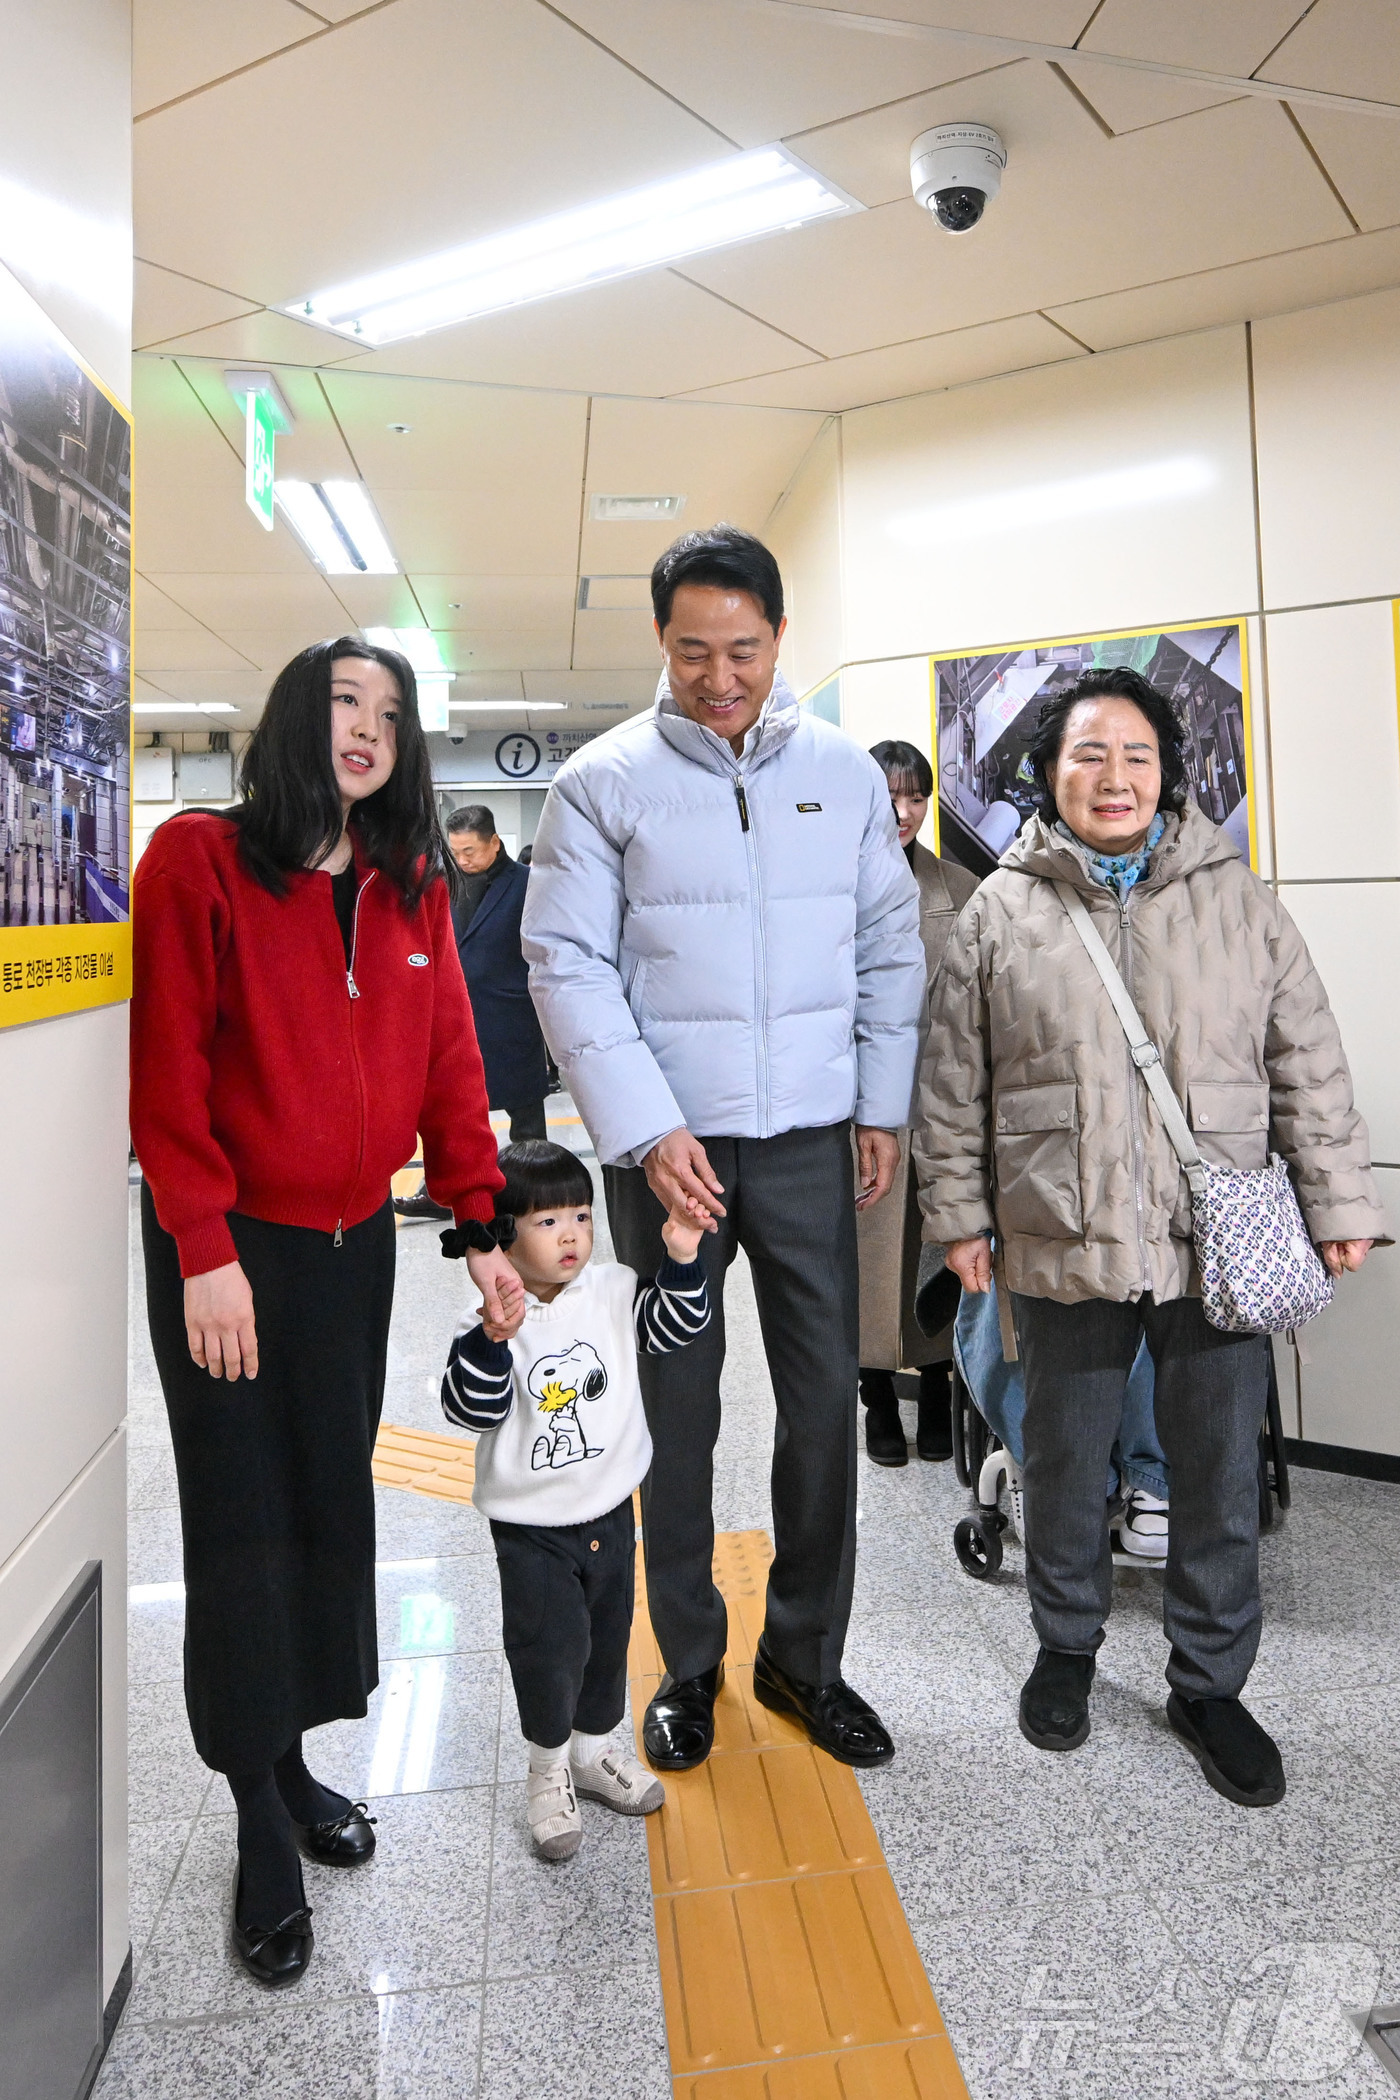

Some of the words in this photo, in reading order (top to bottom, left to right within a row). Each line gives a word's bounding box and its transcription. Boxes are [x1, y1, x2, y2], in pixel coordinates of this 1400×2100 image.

[2, 962, 23, 993] 통로
[25, 958, 54, 989] 천장부
[55, 956, 72, 984] 각종
[74, 953, 98, 981] 지장물
[99, 951, 114, 977] 이설
